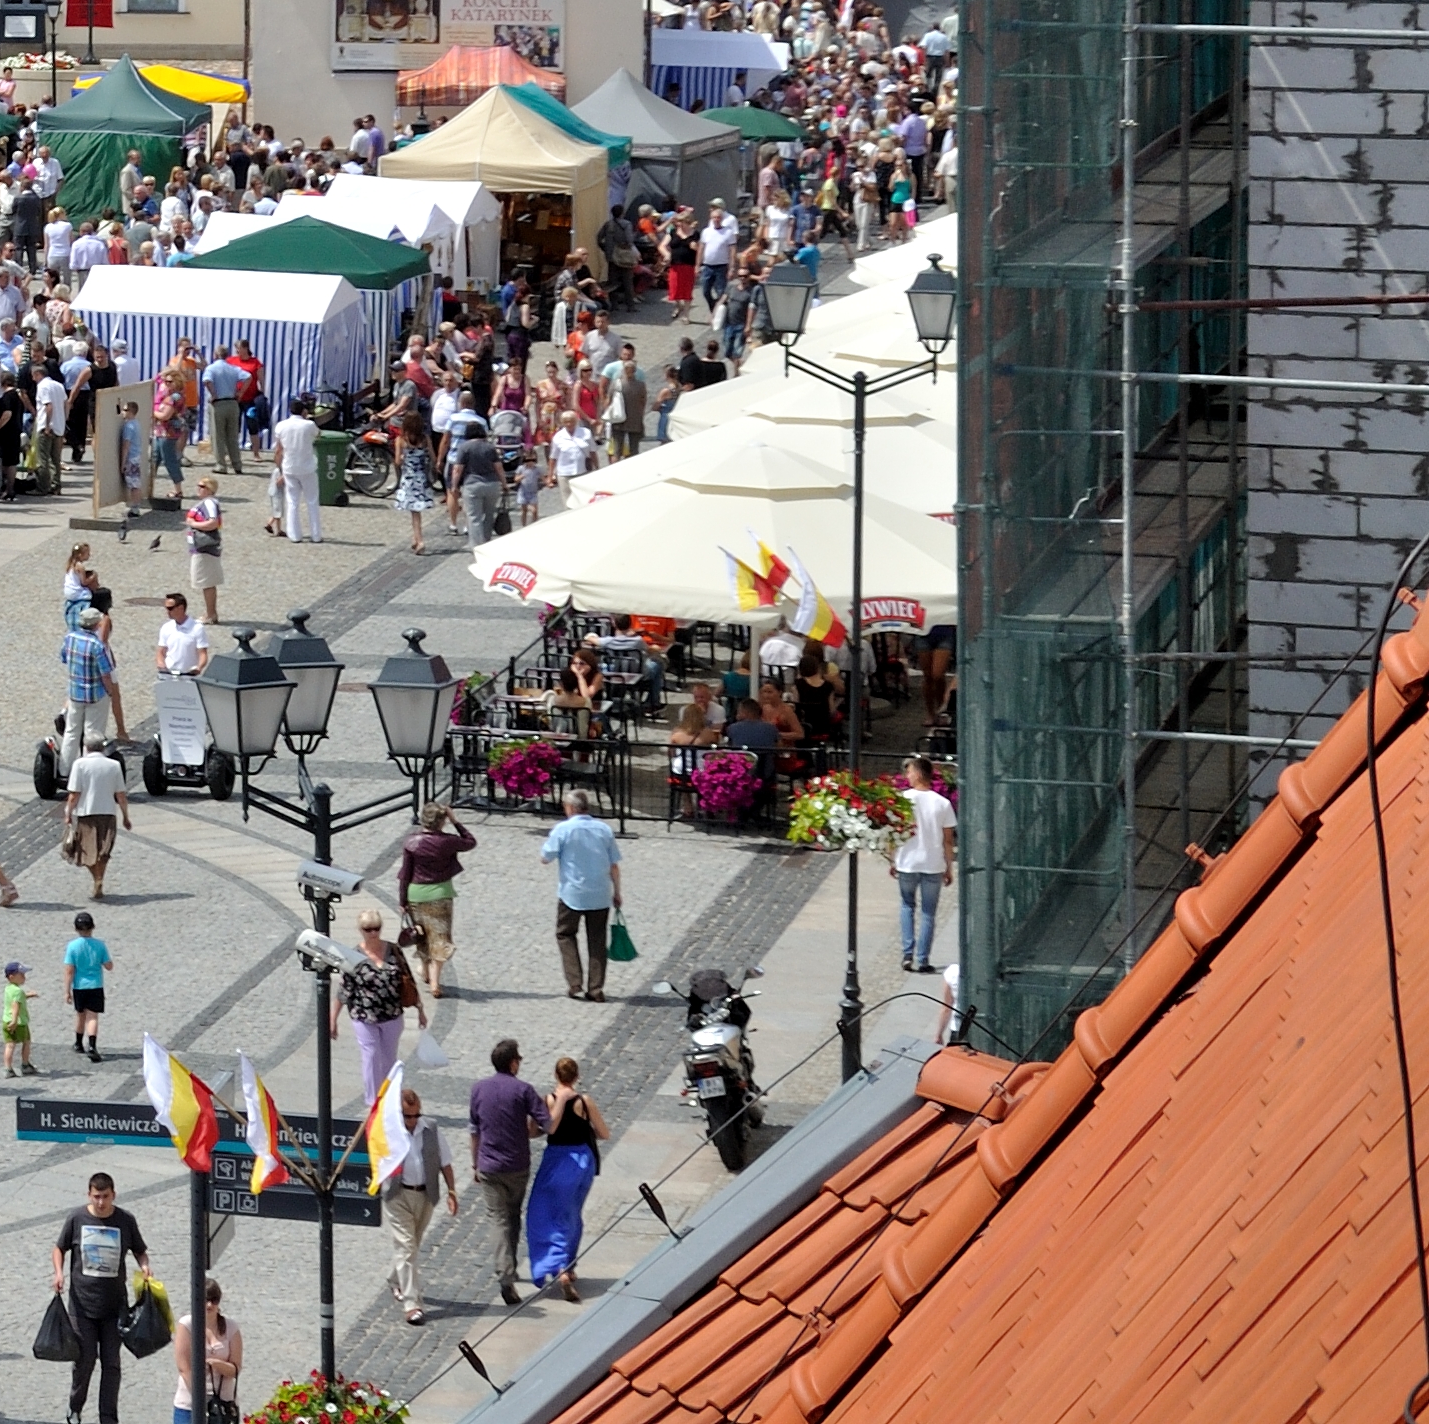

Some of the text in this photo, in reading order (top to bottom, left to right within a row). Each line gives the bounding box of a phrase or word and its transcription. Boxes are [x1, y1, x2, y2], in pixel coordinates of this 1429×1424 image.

[451, 9, 554, 22] KATARYNEK
[40, 1113, 161, 1133] H. Sienkiewicza
